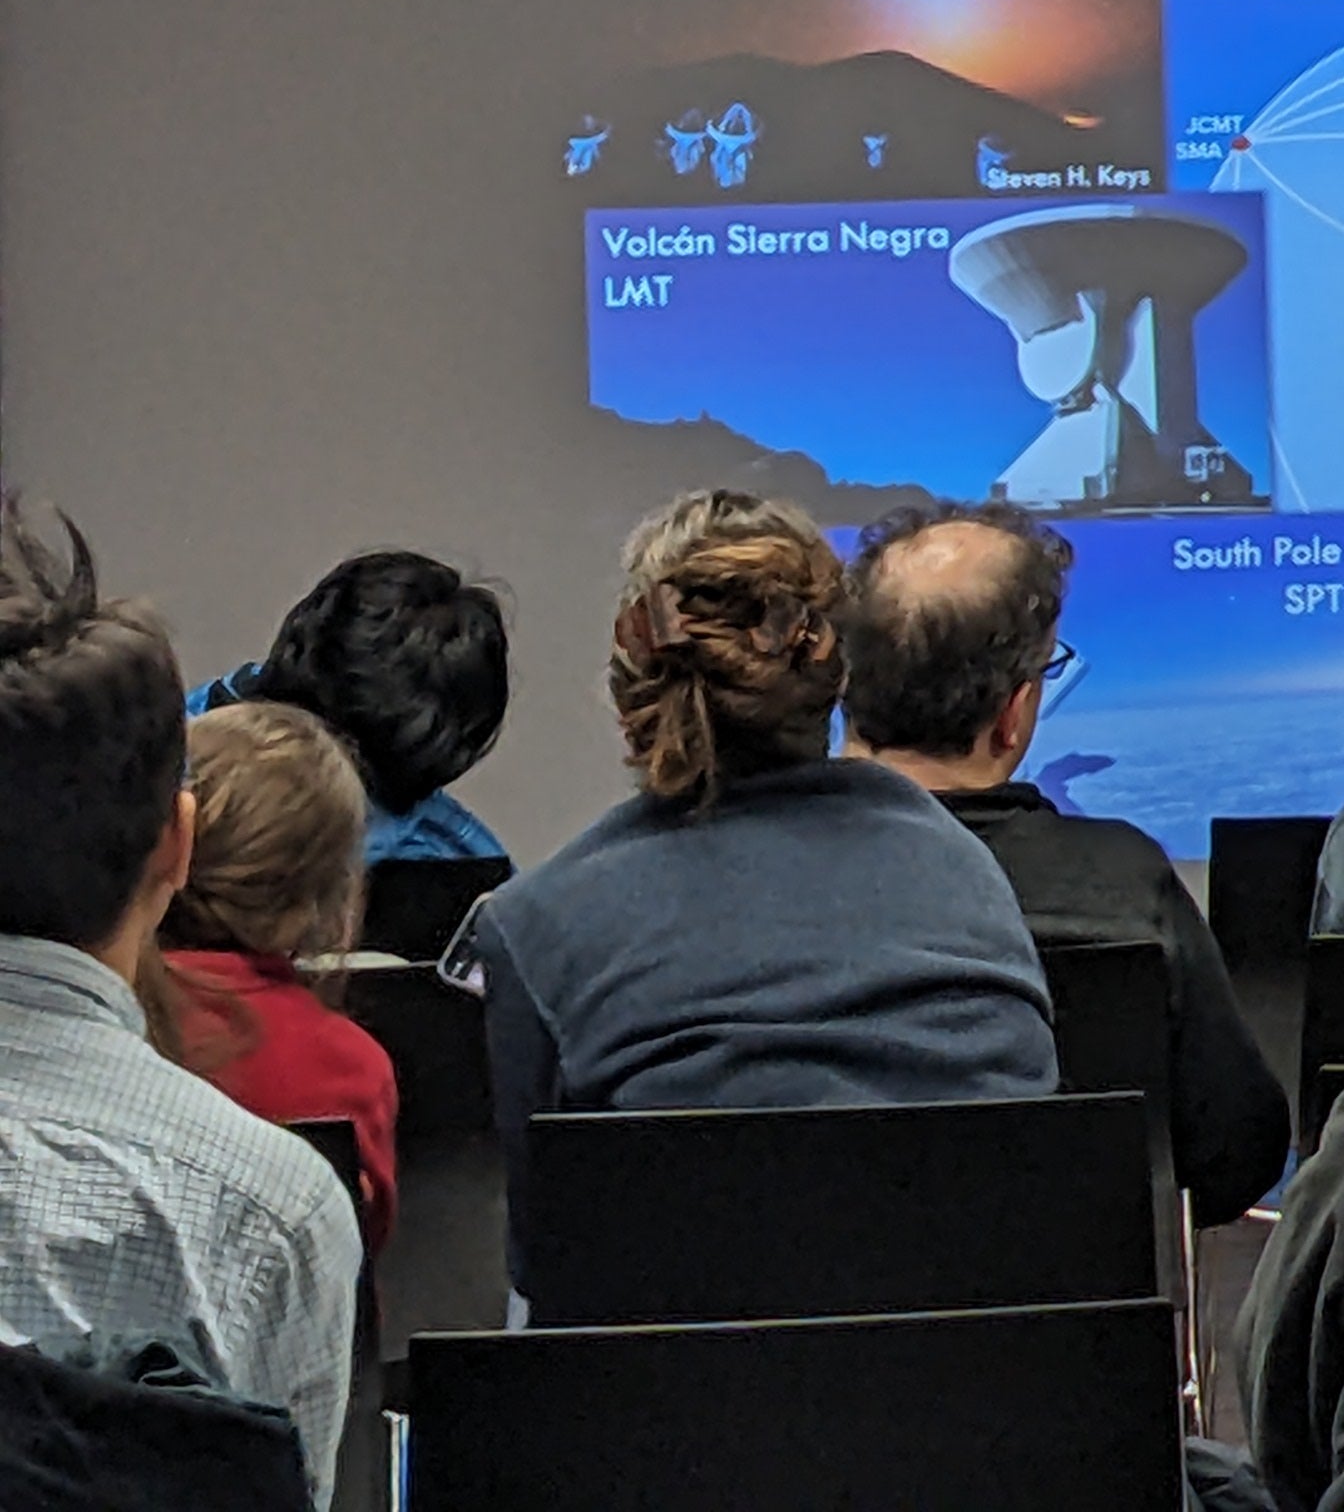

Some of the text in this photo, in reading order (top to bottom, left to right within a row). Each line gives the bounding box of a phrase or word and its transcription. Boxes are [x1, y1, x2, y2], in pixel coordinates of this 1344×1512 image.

[1186, 115, 1244, 134] JCMT
[1175, 142, 1223, 160] SMA
[987, 164, 1150, 190] Steven H. Keys
[602, 221, 949, 258] Volcán Sierra Negra
[604, 275, 673, 308] LMT
[1173, 534, 1342, 570] South Pole
[1284, 583, 1344, 615] SPT
